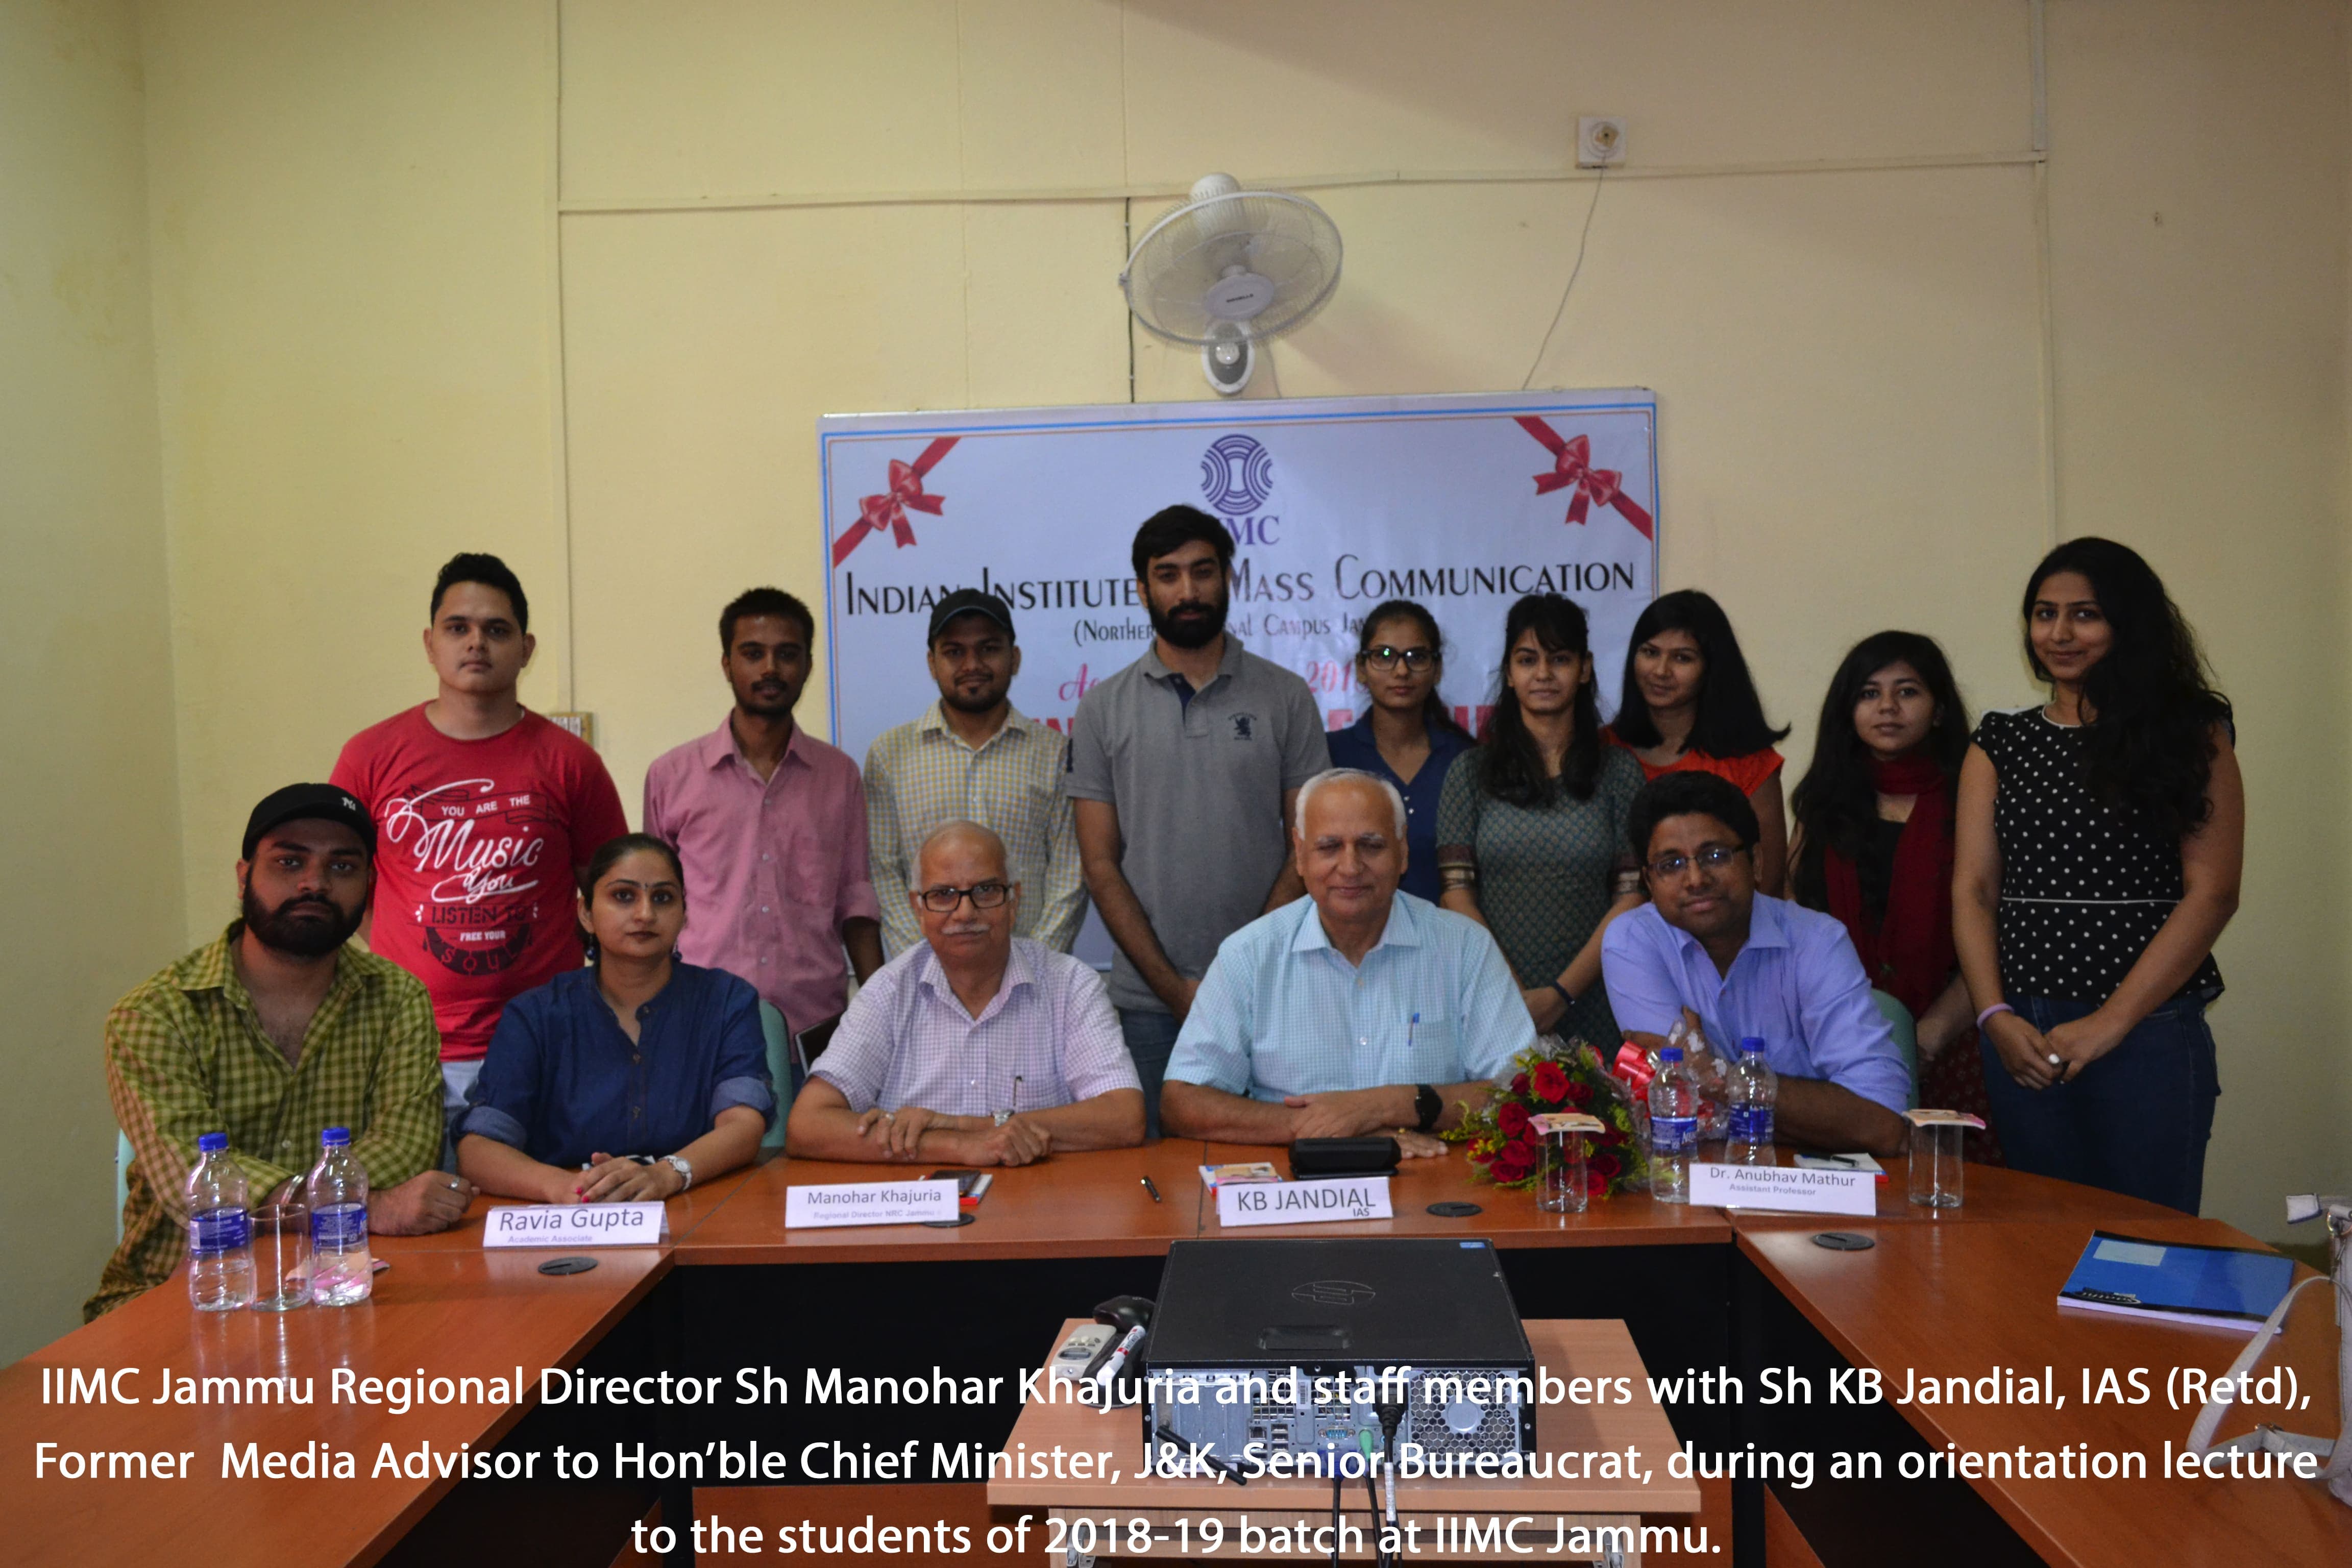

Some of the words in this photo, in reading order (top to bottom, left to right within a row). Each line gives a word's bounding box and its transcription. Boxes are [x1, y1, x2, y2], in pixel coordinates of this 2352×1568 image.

[1229, 557, 1315, 602] MASS
[1335, 554, 1634, 599] COMMUNICATION
[983, 567, 1139, 610] INSTITUTE
[1306, 659, 1369, 694] 201
[441, 805, 464, 816] YOU
[475, 801, 498, 814] ARE
[509, 795, 530, 807] THE
[432, 906, 498, 924] LISTEN
[460, 932, 482, 942] FREE
[484, 930, 506, 940] YOUR
[1710, 1167, 1730, 1179] Dr.
[1735, 1169, 1798, 1183] Anubhav
[1802, 1172, 1856, 1187] Mathur
[807, 1190, 876, 1205] Manohar
[881, 1189, 941, 1205] Khajuria
[1729, 1183, 1771, 1193] Assistant
[1774, 1185, 1816, 1195] Professor
[1238, 1191, 1268, 1211] KB
[1276, 1188, 1376, 1210] JANDIAL
[500, 1210, 562, 1231] Ravia
[571, 1208, 644, 1231] Gupta
[814, 1211, 849, 1220] Regional
[851, 1210, 883, 1218] Director
[1353, 1208, 1370, 1217] IAS
[507, 1235, 549, 1243] Academic
[551, 1234, 593, 1243] Associate
